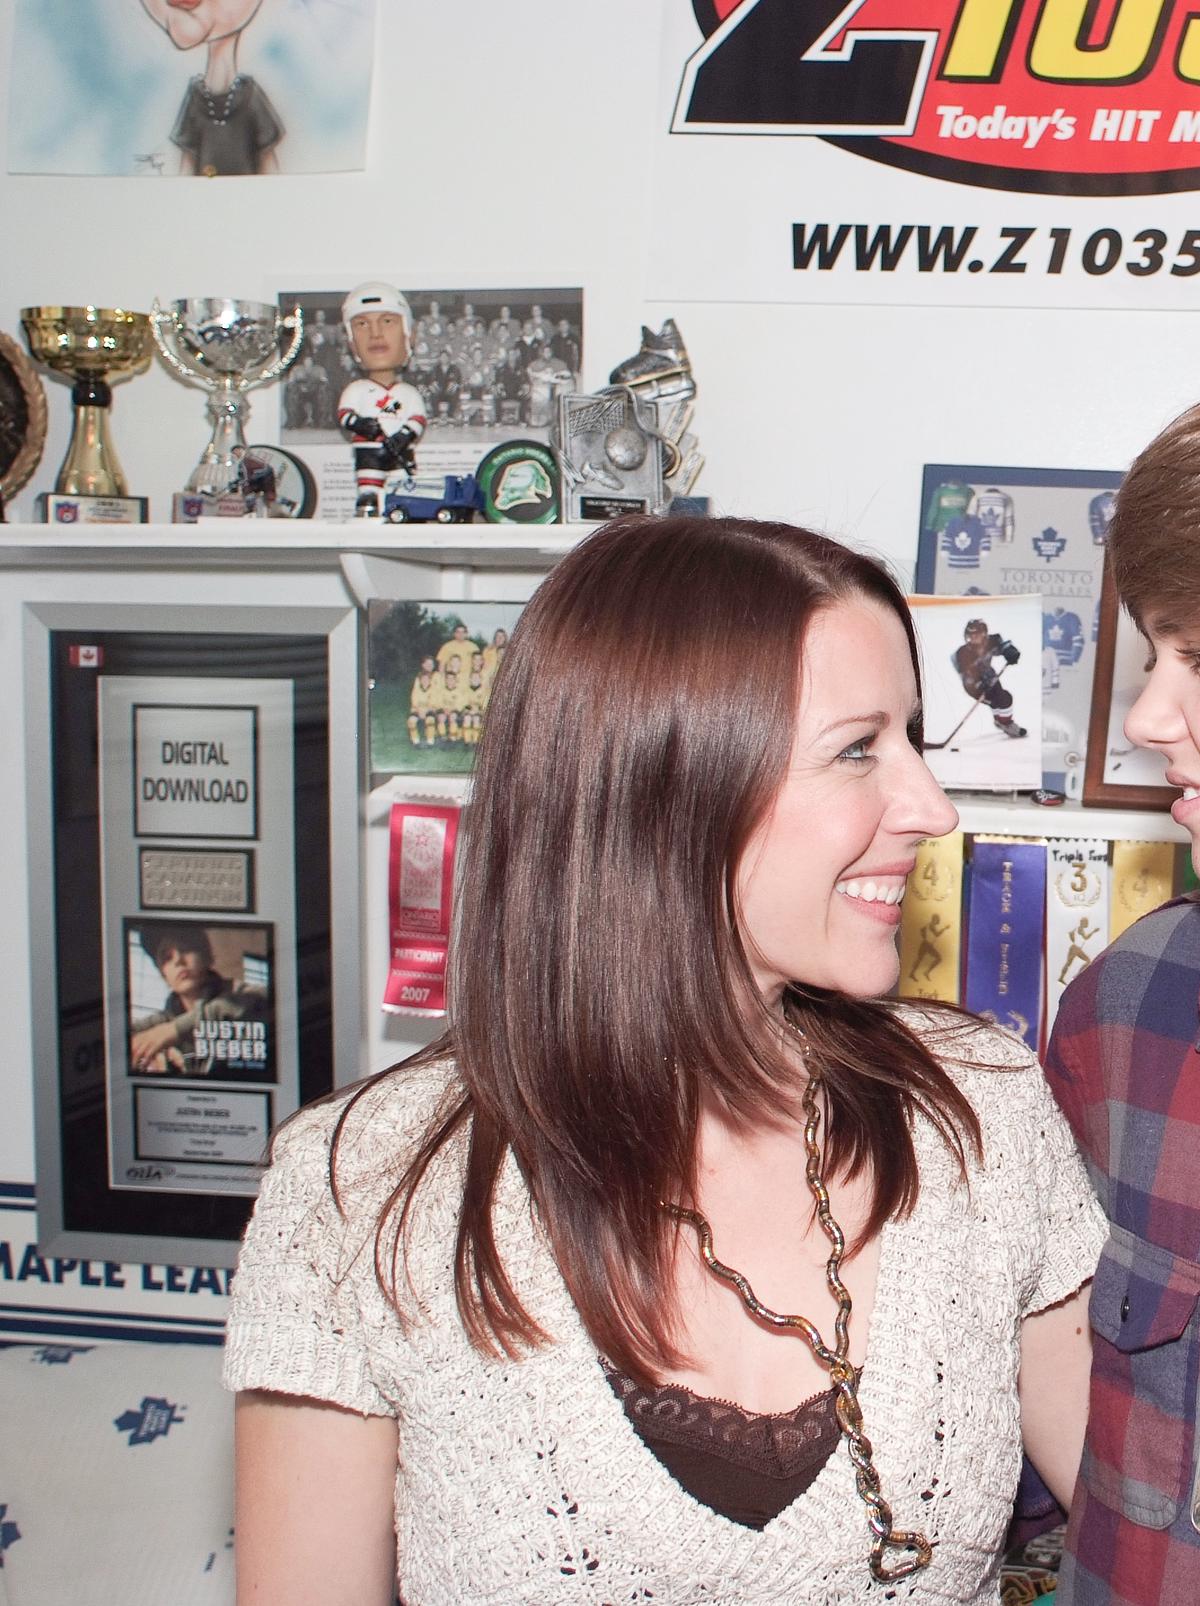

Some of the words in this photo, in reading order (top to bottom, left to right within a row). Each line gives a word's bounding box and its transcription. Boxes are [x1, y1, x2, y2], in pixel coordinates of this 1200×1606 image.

[936, 105, 1077, 149] Today's
[1089, 109, 1161, 142] HIT
[1001, 569, 1094, 585] TORONTO
[162, 741, 230, 765] DIGITAL
[143, 777, 248, 802] DOWNLOAD
[1071, 862, 1088, 893] 3
[401, 986, 430, 1002] 2007
[193, 1020, 266, 1040] JUSTIN
[194, 1039, 267, 1060] BIEBER
